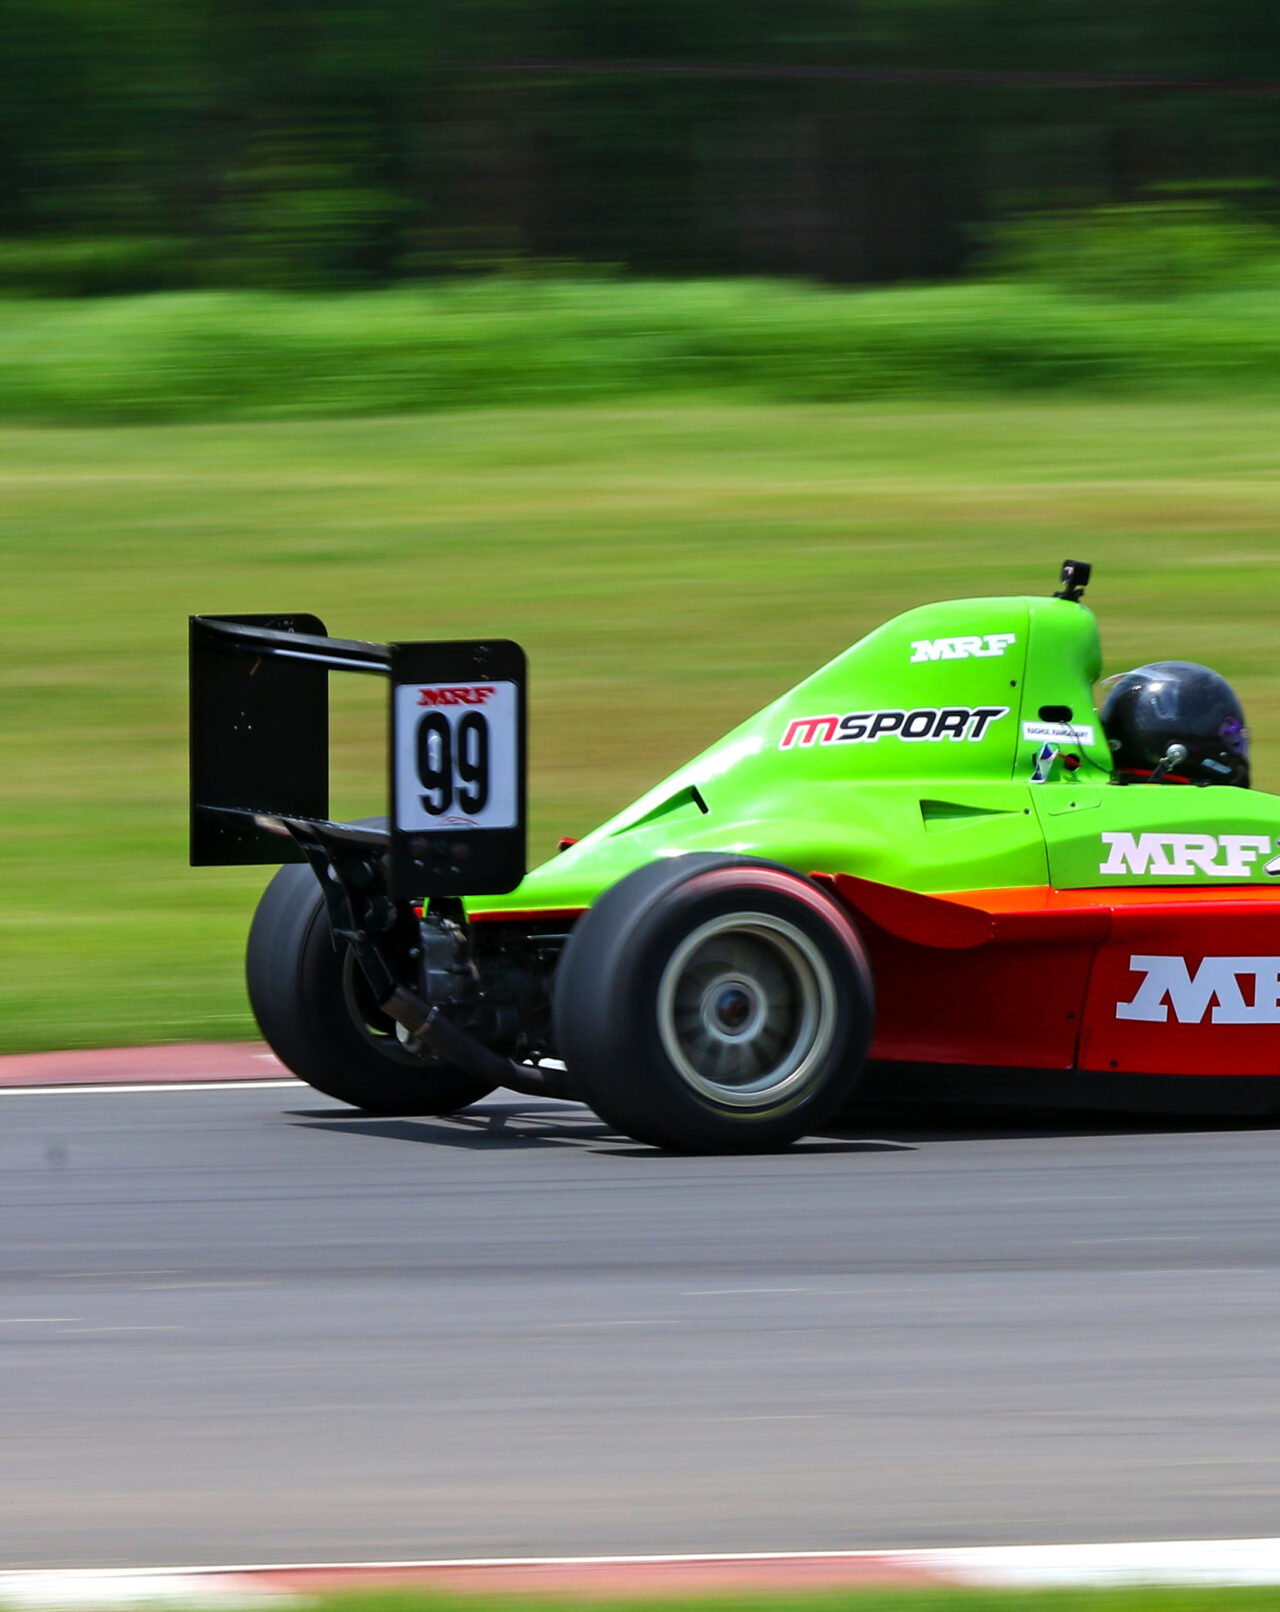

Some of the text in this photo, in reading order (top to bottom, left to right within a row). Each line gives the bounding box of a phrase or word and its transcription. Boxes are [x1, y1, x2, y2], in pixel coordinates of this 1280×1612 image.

[911, 634, 1014, 662] MRF
[418, 687, 495, 705] MRF
[416, 711, 488, 816] 99
[1100, 832, 1271, 876] MRF
